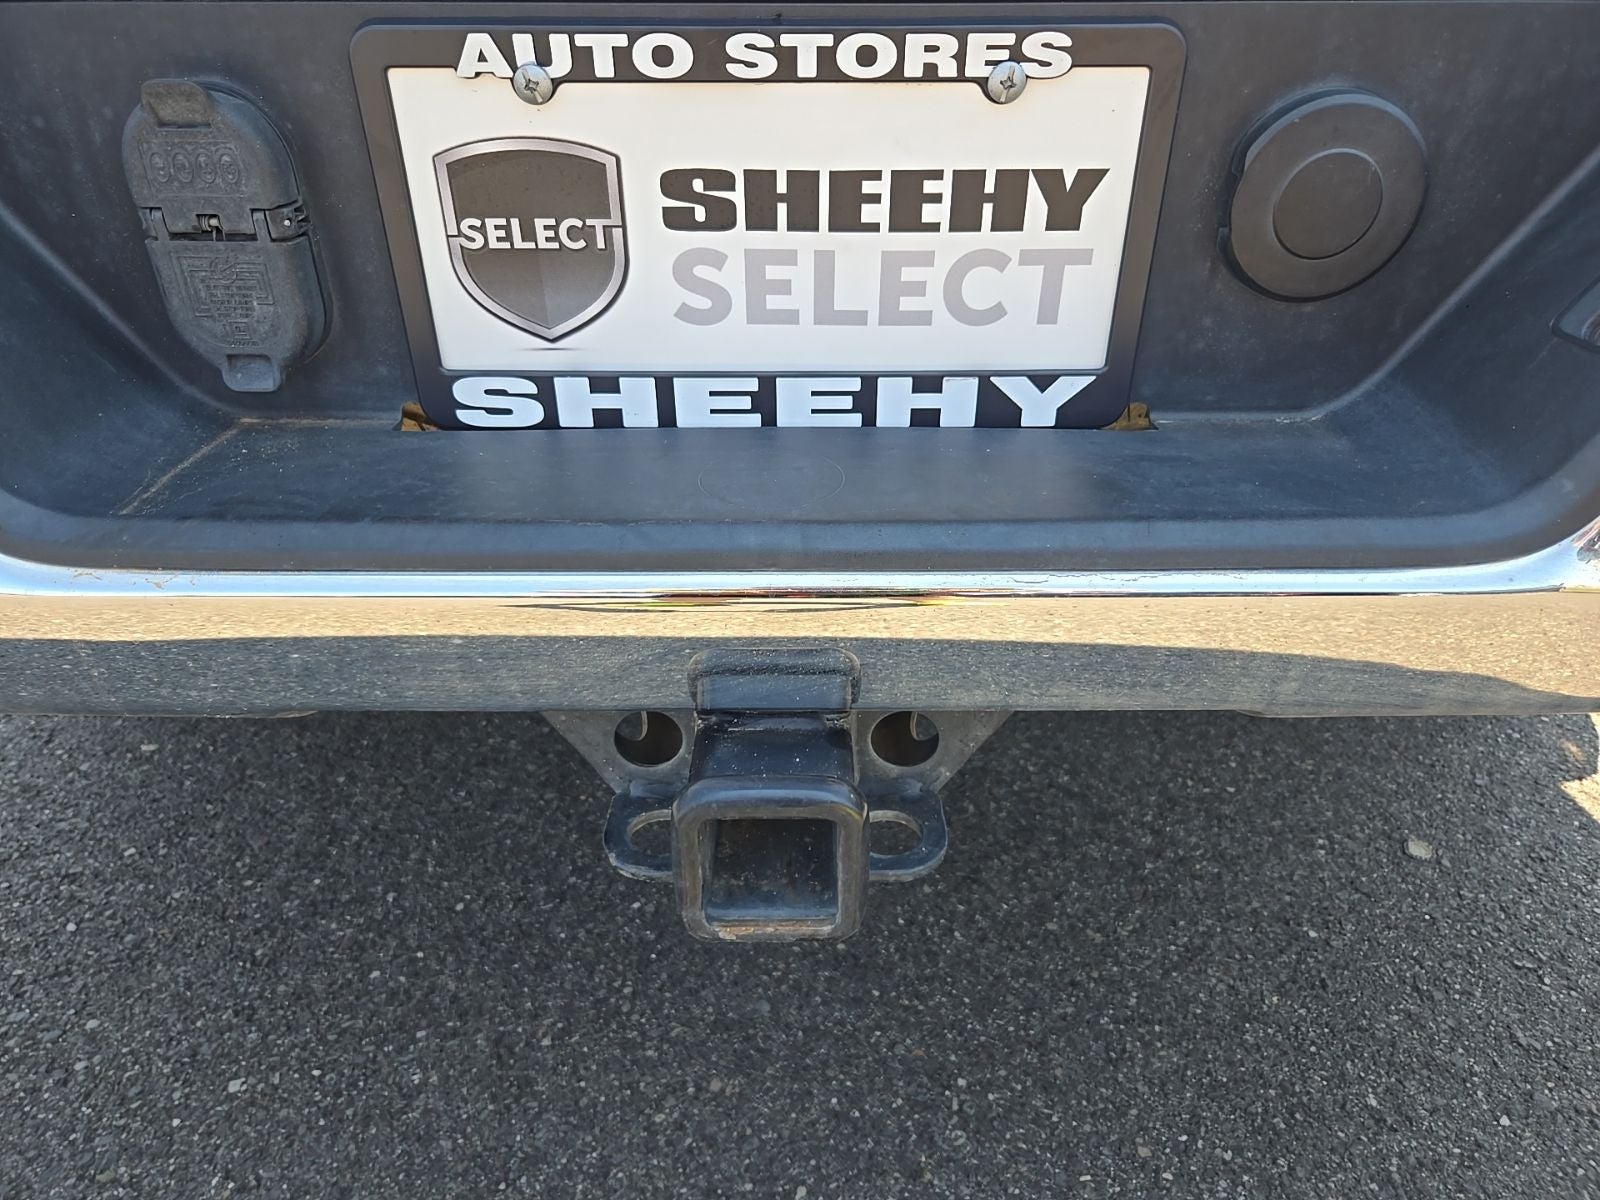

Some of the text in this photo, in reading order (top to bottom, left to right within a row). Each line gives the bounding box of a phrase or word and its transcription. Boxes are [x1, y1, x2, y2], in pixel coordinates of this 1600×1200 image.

[456, 31, 1073, 79] AUTO STORES
[660, 168, 1111, 232] SHEEHY
[459, 217, 611, 250] SELECT
[671, 247, 1094, 327] SELECT
[452, 376, 1097, 428] SHEEHY
